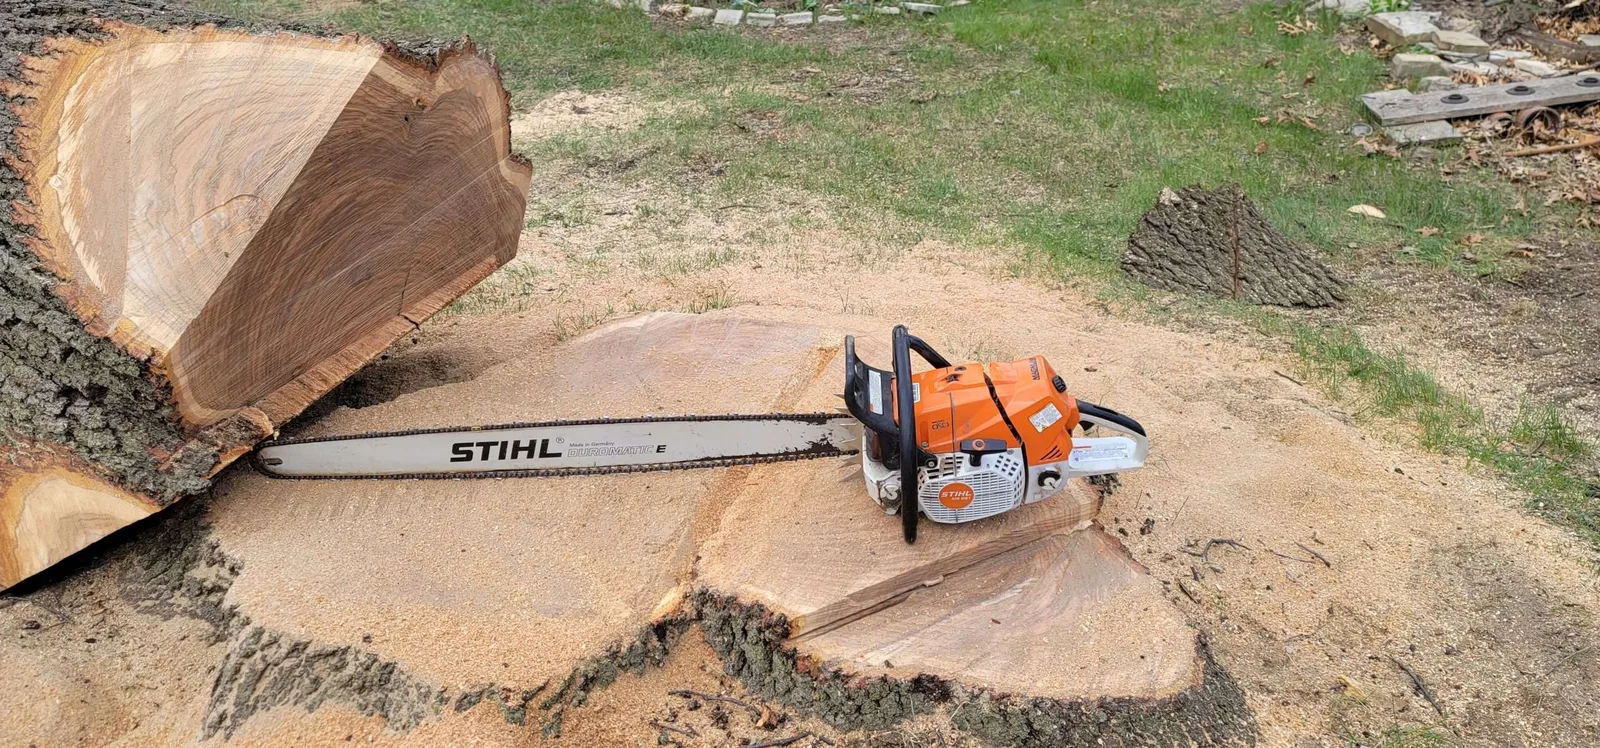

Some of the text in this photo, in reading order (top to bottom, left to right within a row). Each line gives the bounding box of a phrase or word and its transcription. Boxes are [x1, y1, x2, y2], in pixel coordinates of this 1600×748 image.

[567, 444, 667, 458] DUROMATIC E
[941, 490, 972, 498] STIHL
